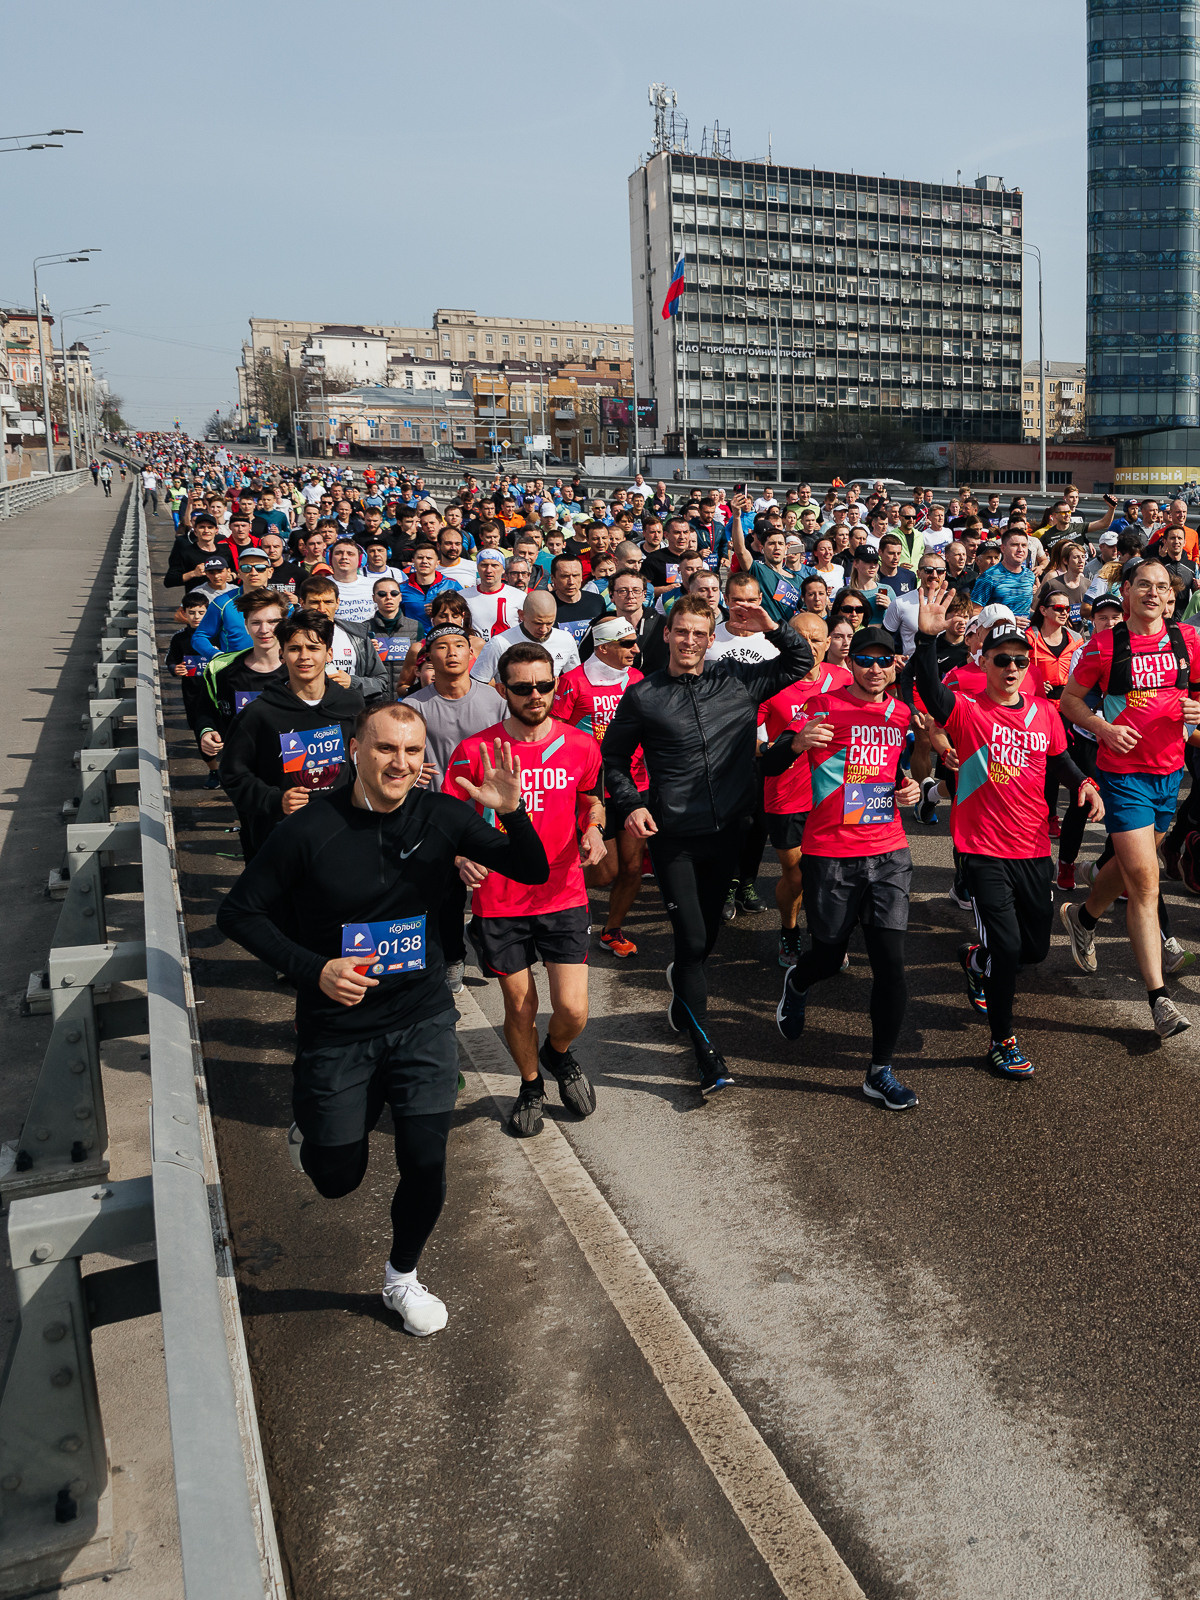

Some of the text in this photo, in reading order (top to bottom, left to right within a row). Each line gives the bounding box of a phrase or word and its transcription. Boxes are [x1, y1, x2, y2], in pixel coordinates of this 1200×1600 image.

[678, 344, 699, 353] ОАО
[1116, 470, 1183, 481] ОГНЕННЫЙ
[205, 559, 223, 567] FILA
[992, 624, 1026, 639] UFC
[1132, 653, 1178, 673] ОСТО
[1128, 698, 1148, 708] 2022
[850, 725, 904, 747] РОСТОВ-
[991, 722, 1050, 752] РОСТОВ-
[307, 738, 341, 755] 0197
[990, 742, 1031, 767] СКОЕ
[849, 745, 889, 767] СКОЕ
[847, 764, 880, 777] КОЛЬЦО
[990, 761, 1021, 777] КОЛЬЦО
[521, 768, 574, 791] СТОВ-
[846, 774, 867, 784] 2022
[990, 772, 1010, 784] 2022
[522, 790, 545, 813] ОЕ
[866, 796, 893, 810] 2056
[377, 935, 422, 956] 0138
